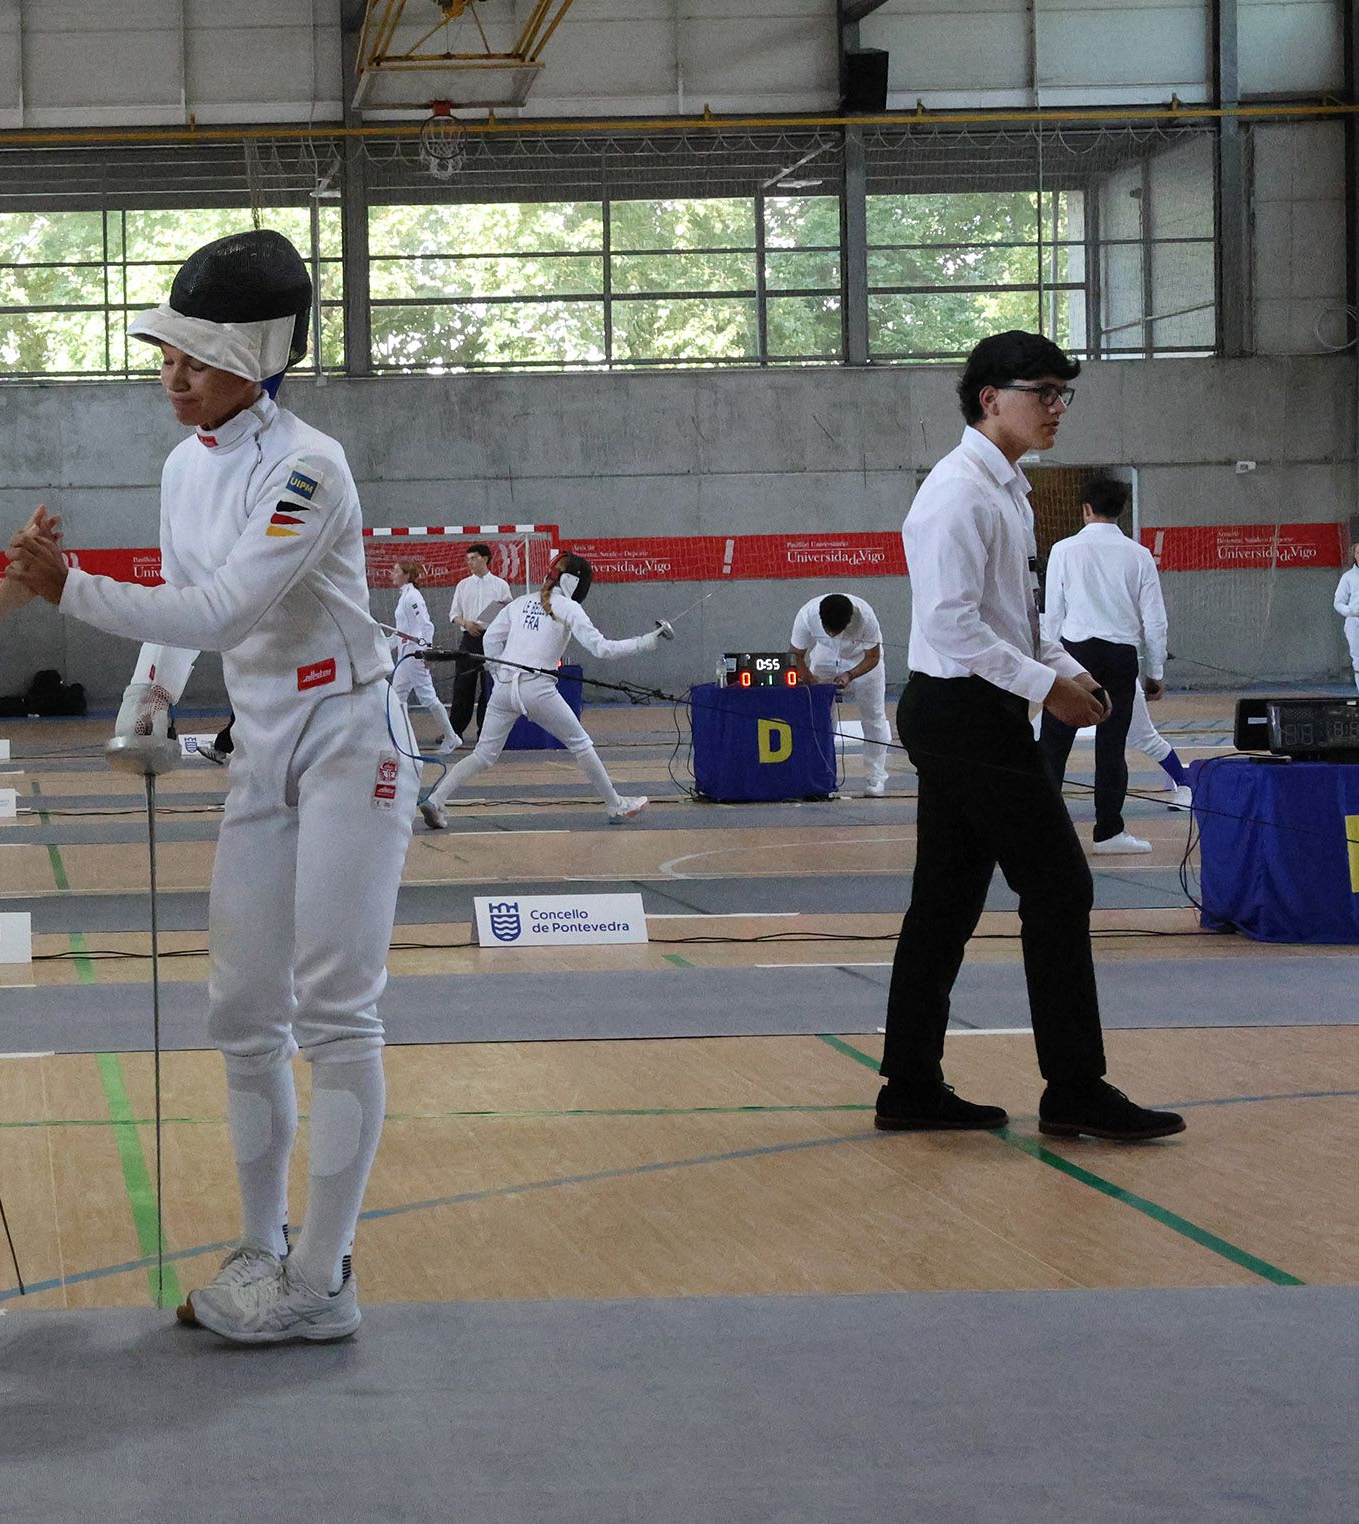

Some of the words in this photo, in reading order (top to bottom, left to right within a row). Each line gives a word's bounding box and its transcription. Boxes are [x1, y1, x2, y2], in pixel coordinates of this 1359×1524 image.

[290, 477, 314, 494] UIPM
[523, 614, 540, 631] FRA
[755, 658, 780, 671] 0:55
[742, 672, 751, 686] 0
[787, 671, 797, 685] 0
[757, 718, 793, 764] D
[530, 909, 589, 920] Concello
[532, 923, 549, 933] de
[552, 921, 630, 932] Pontevedra
